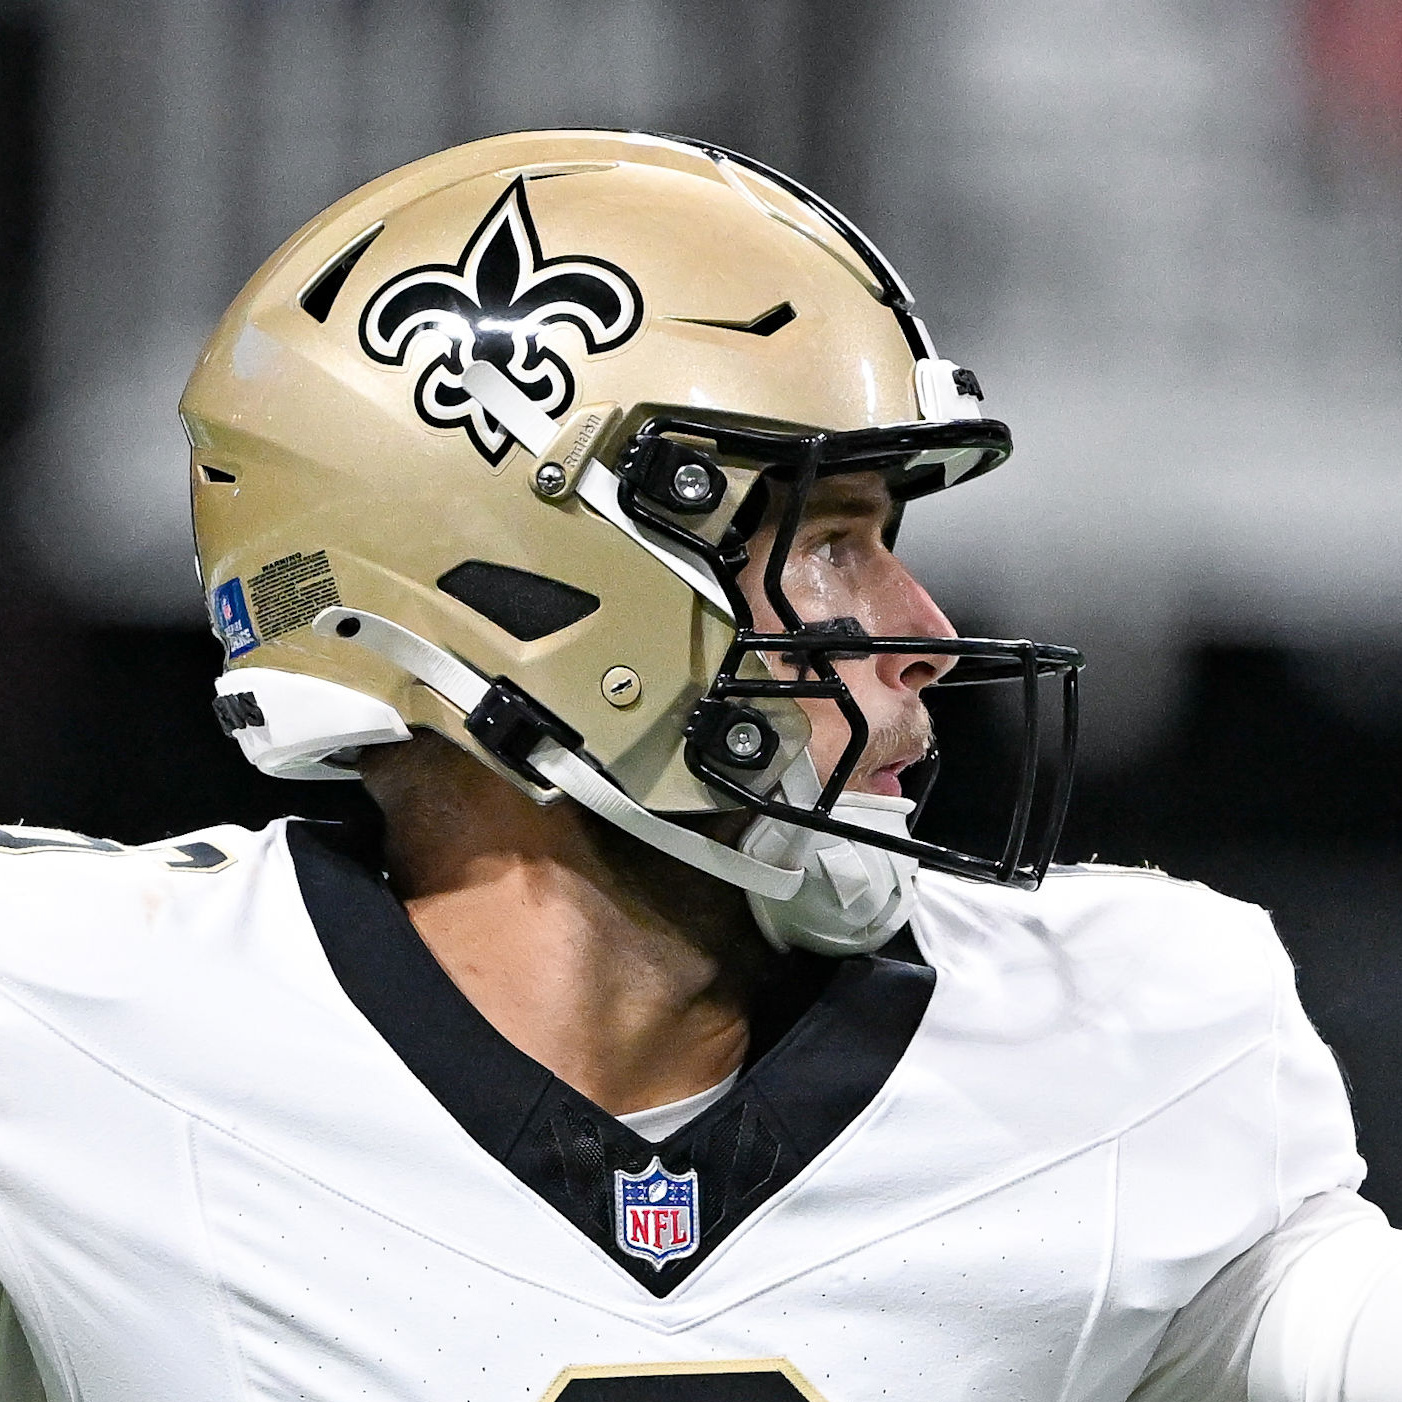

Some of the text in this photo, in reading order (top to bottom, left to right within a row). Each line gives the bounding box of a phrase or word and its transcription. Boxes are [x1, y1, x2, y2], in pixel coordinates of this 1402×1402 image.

[563, 414, 602, 468] Riddell
[261, 551, 302, 573] WARNING
[630, 1209, 689, 1249] NFL
